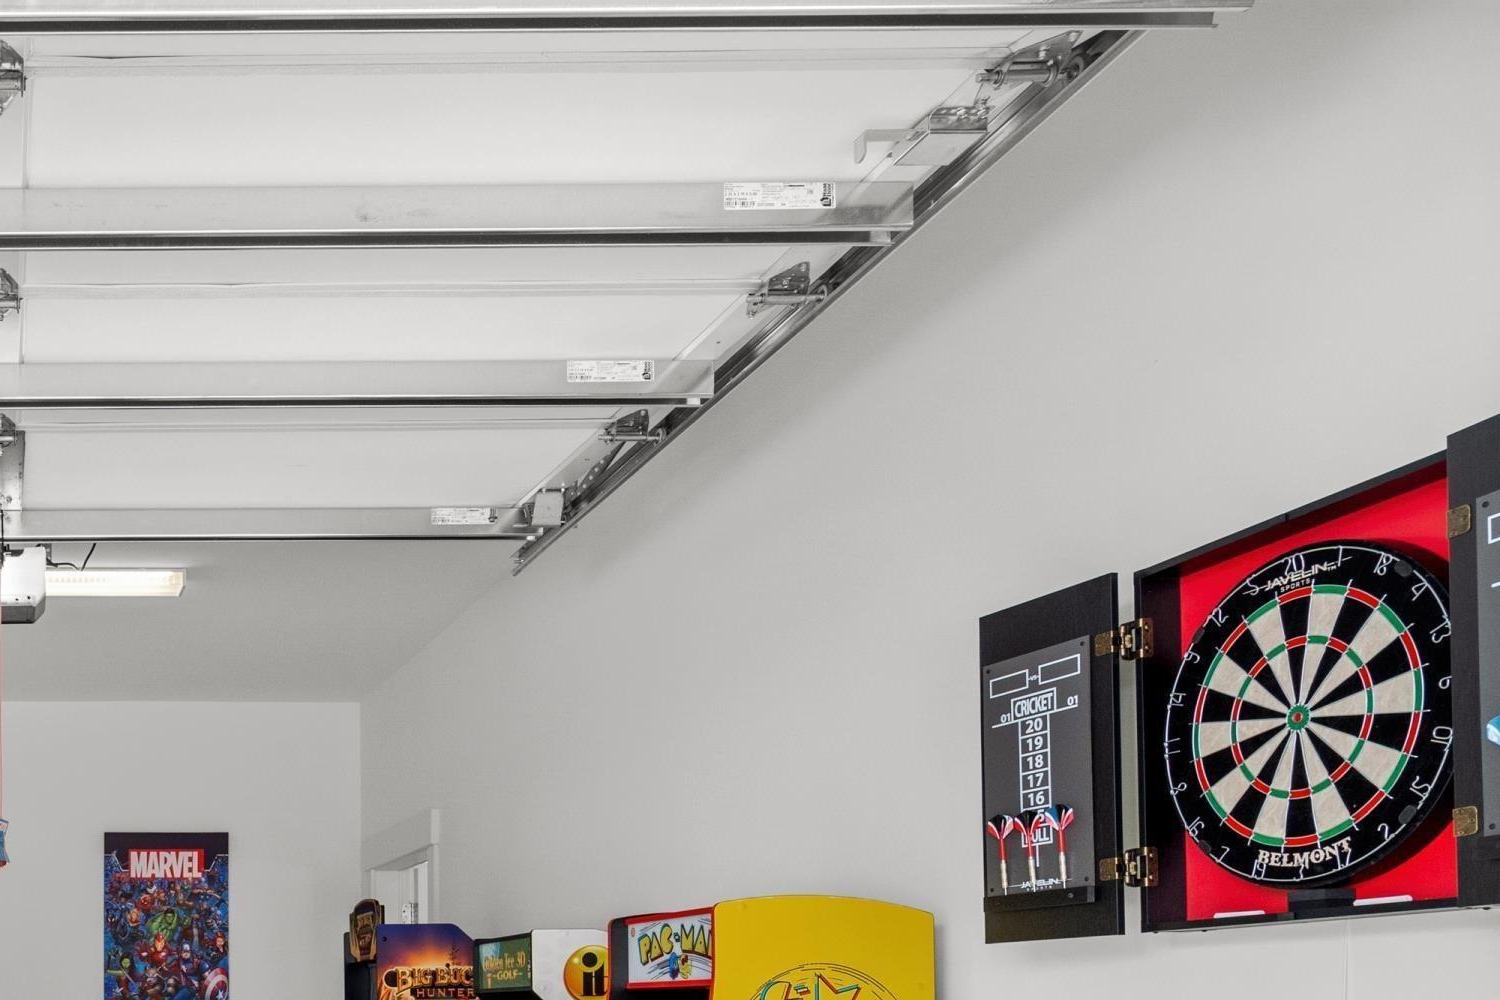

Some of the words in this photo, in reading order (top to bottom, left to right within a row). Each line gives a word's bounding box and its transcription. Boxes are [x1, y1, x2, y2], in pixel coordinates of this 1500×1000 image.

[1284, 552, 1306, 577] 20
[1373, 552, 1393, 576] 18
[1246, 576, 1260, 596] 5
[1264, 561, 1328, 592] JAVELIN
[1280, 577, 1311, 593] SPORTS
[1411, 581, 1429, 601] 4
[1208, 606, 1229, 628] 12
[1429, 614, 1452, 644] 13
[1000, 713, 1012, 724] 01
[1014, 692, 1053, 718] CRICKET
[1067, 694, 1079, 706] 01
[1169, 692, 1187, 713] 14
[1025, 717, 1043, 734] 20
[1026, 736, 1043, 752] 19
[1429, 725, 1454, 751] 10
[1026, 754, 1044, 770] 18
[1027, 772, 1044, 789] 17
[1409, 775, 1432, 806] 15
[1027, 791, 1045, 807] 16
[1188, 816, 1206, 838] 16
[1377, 822, 1396, 841] 2
[1216, 846, 1231, 864] 7
[1256, 836, 1352, 868] BELMONT
[130, 851, 202, 878] MARVEL
[395, 966, 433, 993] BIG
[416, 988, 475, 998] HUNTER
